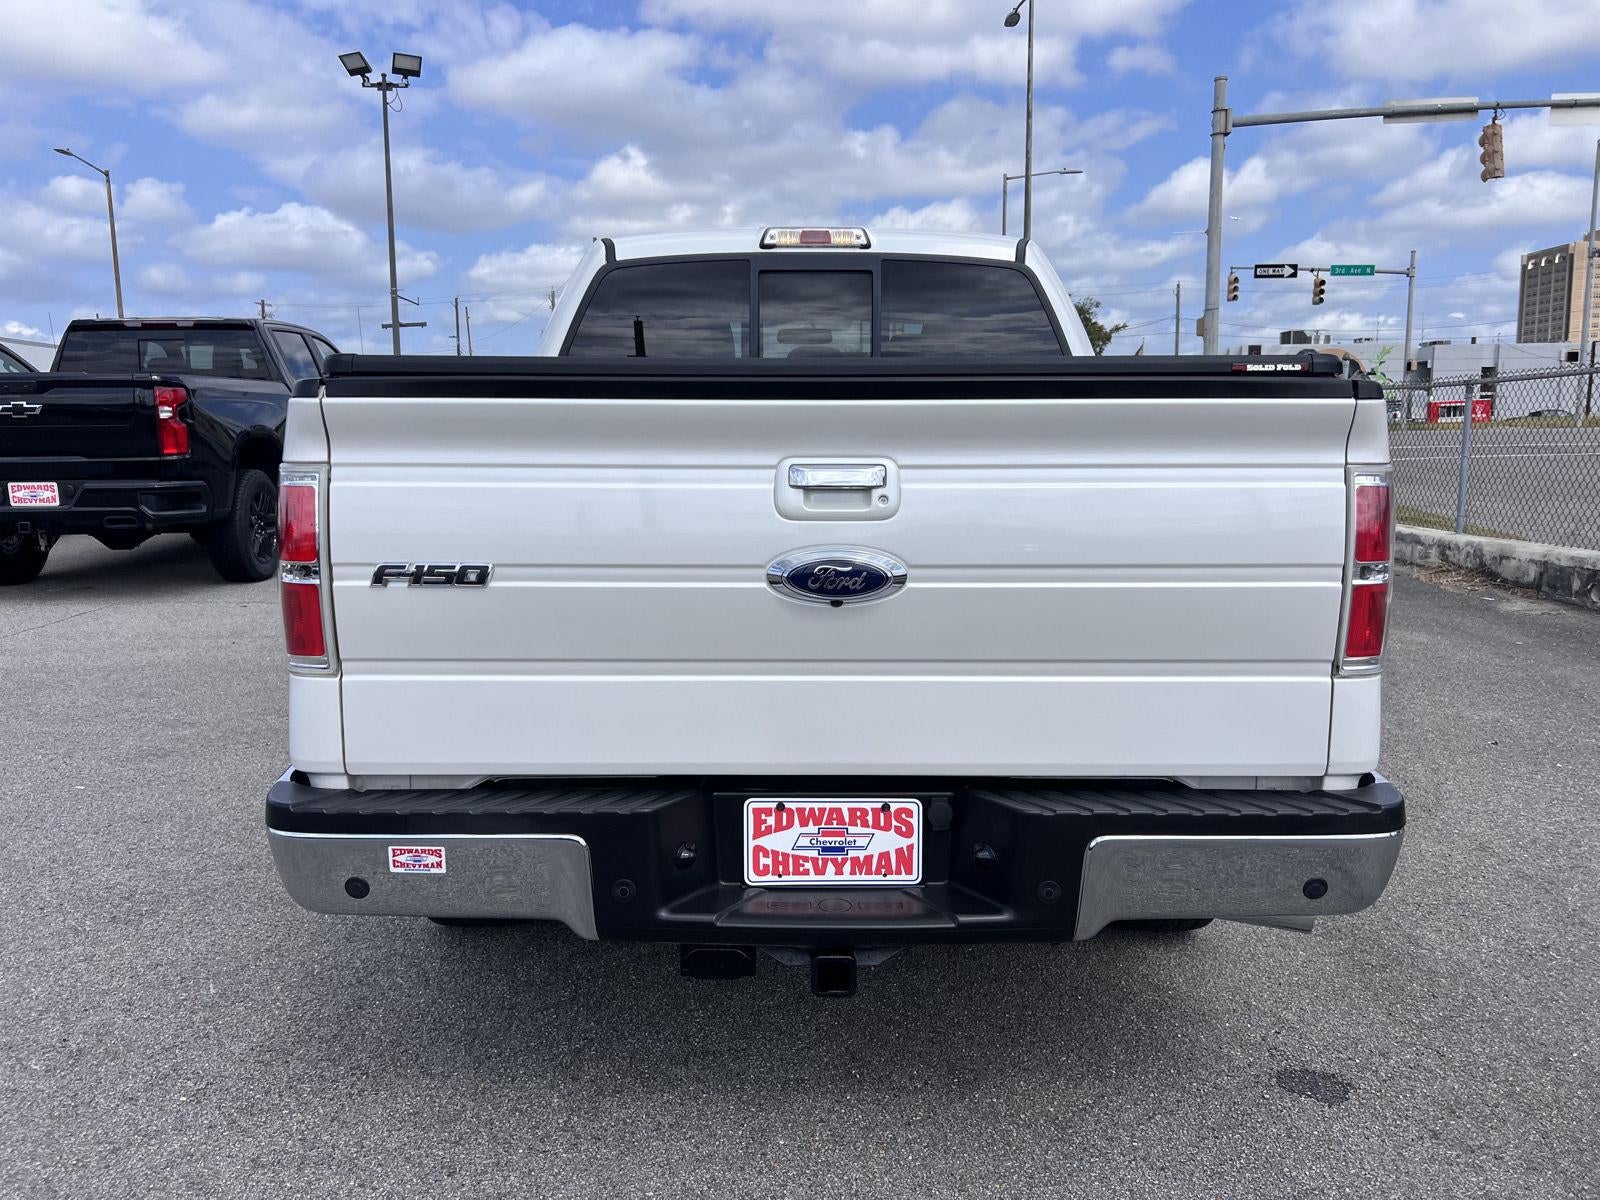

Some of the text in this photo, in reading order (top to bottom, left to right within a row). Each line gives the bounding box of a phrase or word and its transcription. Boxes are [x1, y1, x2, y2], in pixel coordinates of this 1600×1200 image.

[10, 484, 56, 493] EDWARDS
[12, 495, 57, 504] CHEVYMAN
[370, 561, 495, 588] F-150
[807, 565, 867, 590] Ford
[752, 806, 915, 841] EDWARDS
[809, 837, 857, 846] Chevrolet
[391, 848, 443, 858] EDWARDS
[391, 859, 443, 869] CHEVYMAN
[752, 843, 915, 877] CHEVYMAN
